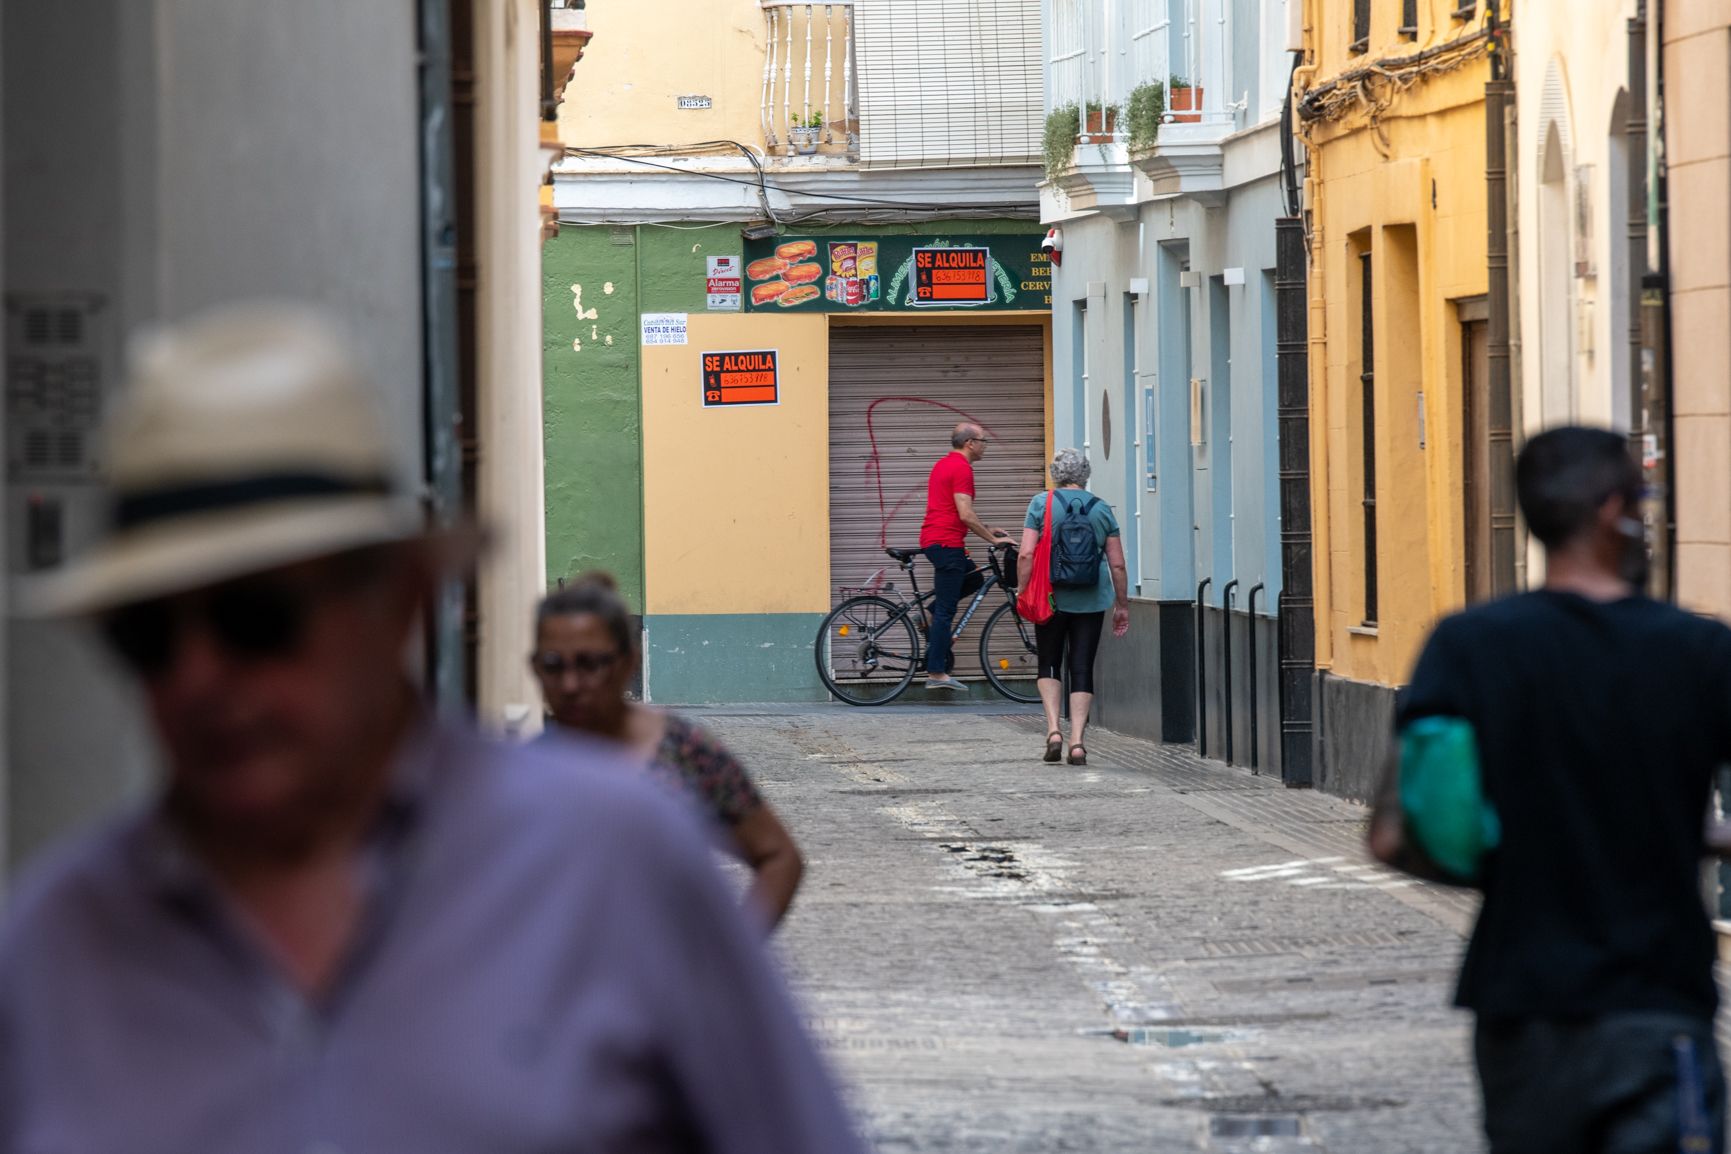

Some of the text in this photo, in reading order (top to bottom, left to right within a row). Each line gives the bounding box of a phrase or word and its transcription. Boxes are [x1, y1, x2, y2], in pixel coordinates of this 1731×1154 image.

[917, 251, 985, 268] SE ALQUILA
[1030, 253, 1051, 262] EM
[708, 279, 740, 287] Alarma
[643, 326, 661, 334] VENTA
[670, 326, 687, 334] HIELO
[705, 354, 774, 372] SE ALQUILA
